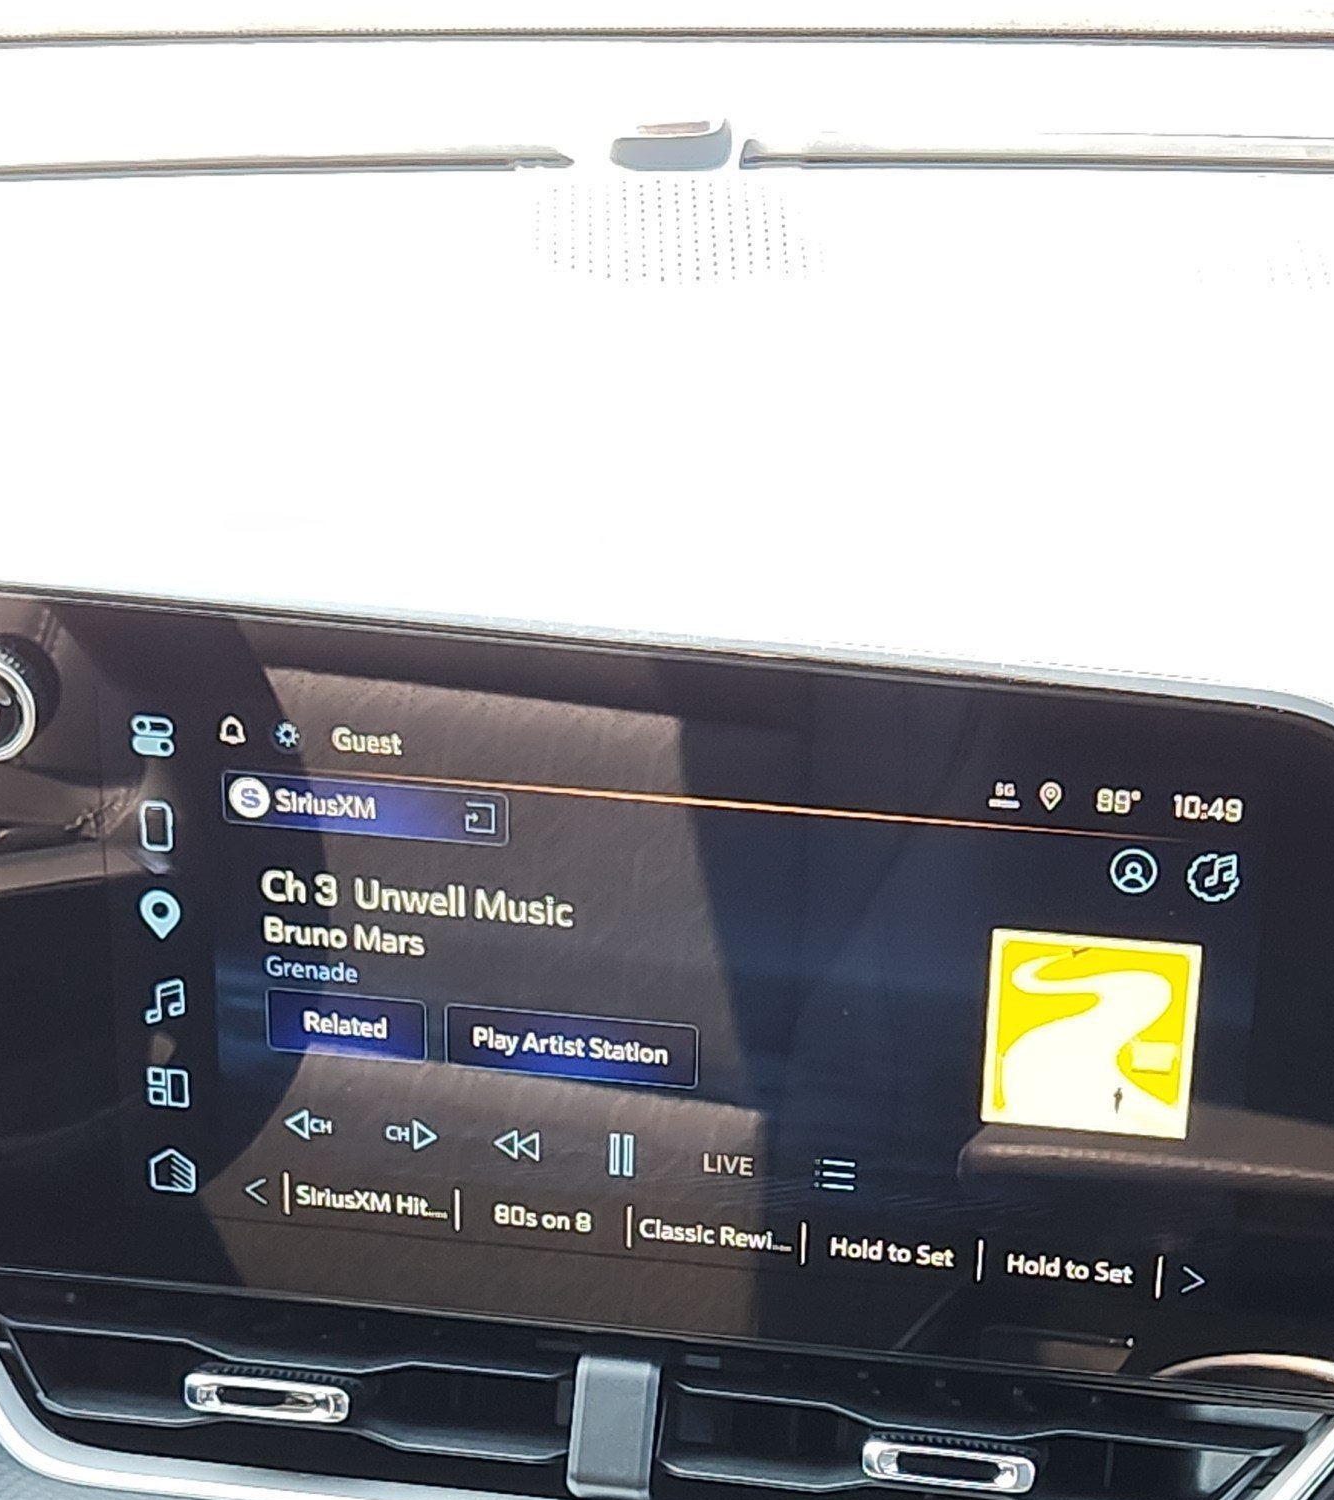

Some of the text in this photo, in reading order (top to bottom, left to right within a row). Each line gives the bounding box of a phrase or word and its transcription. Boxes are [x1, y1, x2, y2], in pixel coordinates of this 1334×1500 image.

[331, 727, 404, 756] Guest
[275, 788, 377, 820] SiriusXM
[1173, 793, 1244, 823] 10:49
[261, 870, 574, 928] Ch 3 Unwell Music
[263, 916, 425, 957] Bruno Mars
[266, 956, 359, 984] Grenade
[302, 1010, 387, 1040] Related
[472, 1026, 668, 1066] Play Artist Station
[309, 1117, 333, 1135] CH
[385, 1125, 410, 1142] CH
[702, 1152, 755, 1178] LIVE
[295, 1184, 392, 1215] SiriusXM
[493, 1203, 593, 1233] 80s on 8
[638, 1217, 716, 1245] Classic
[830, 1236, 955, 1268] Hold to Set
[1007, 1253, 1134, 1285] Hold to Set
